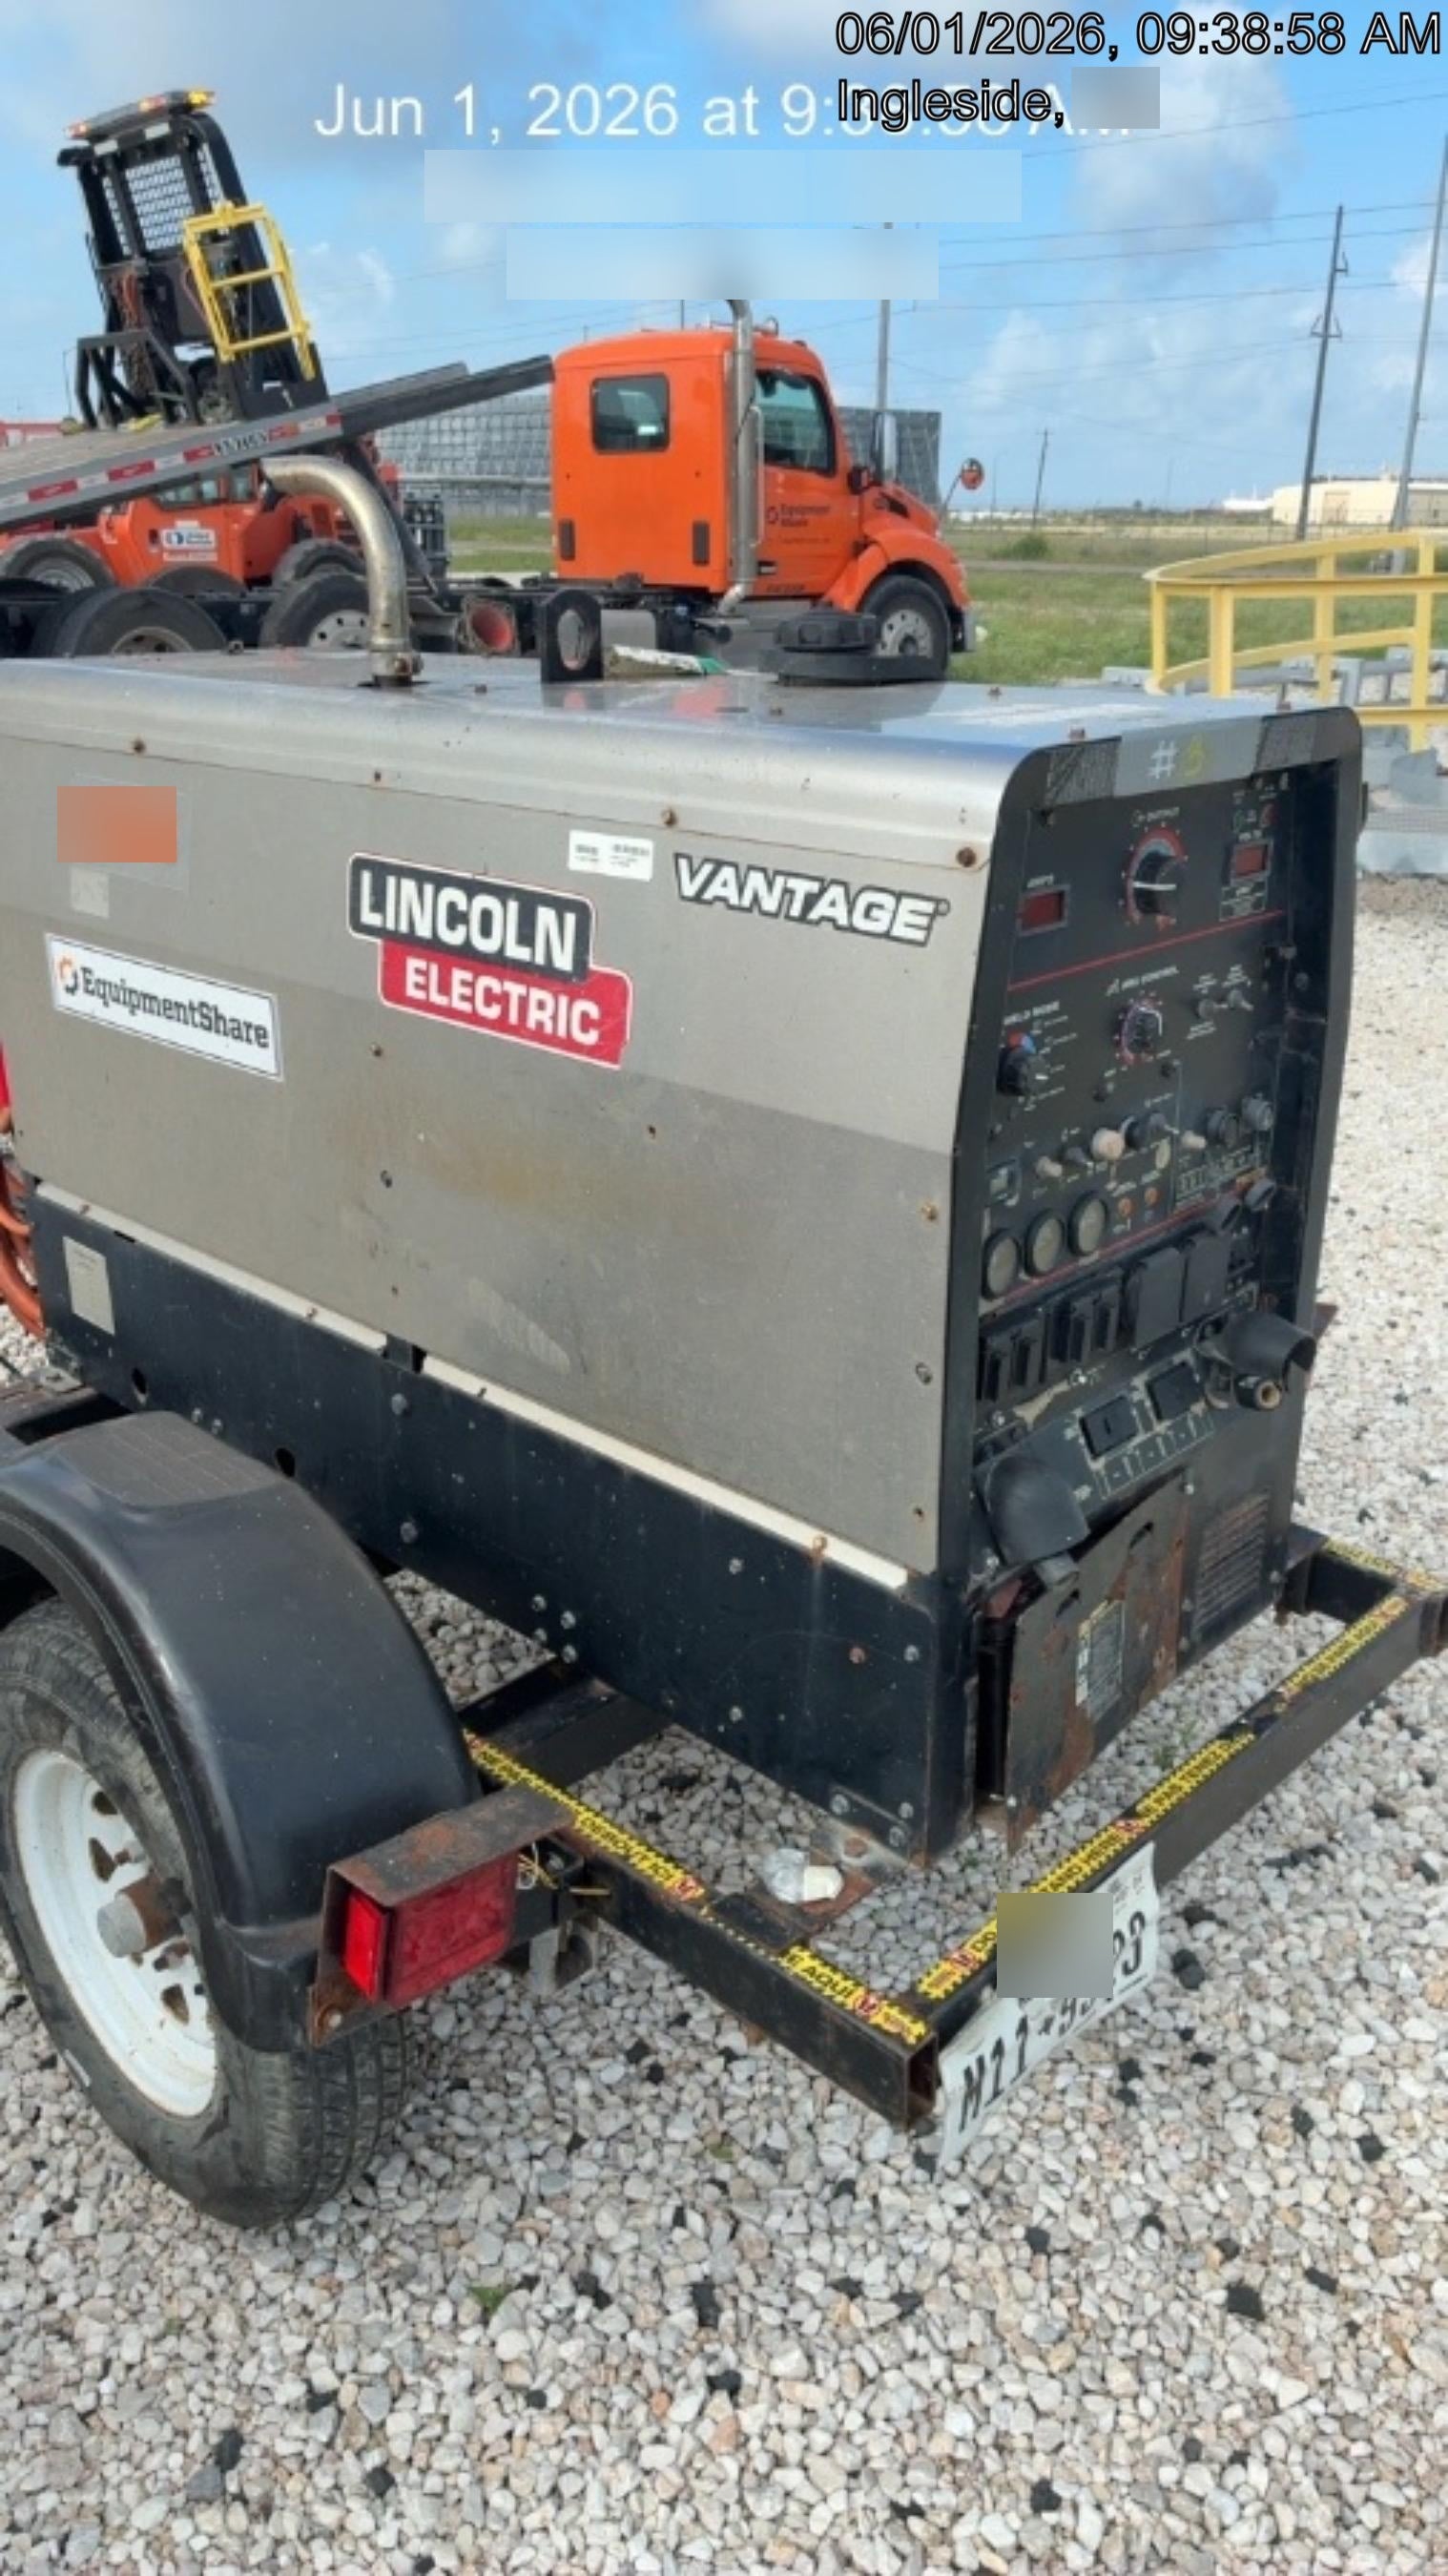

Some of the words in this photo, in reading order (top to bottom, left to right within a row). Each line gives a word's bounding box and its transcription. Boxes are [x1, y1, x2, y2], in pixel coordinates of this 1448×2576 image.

[359, 868, 577, 973] LINCOLN
[673, 853, 937, 946] VANTAGE
[81, 966, 271, 1050] EquipmentShare
[403, 956, 601, 1047] ELECTRIC
